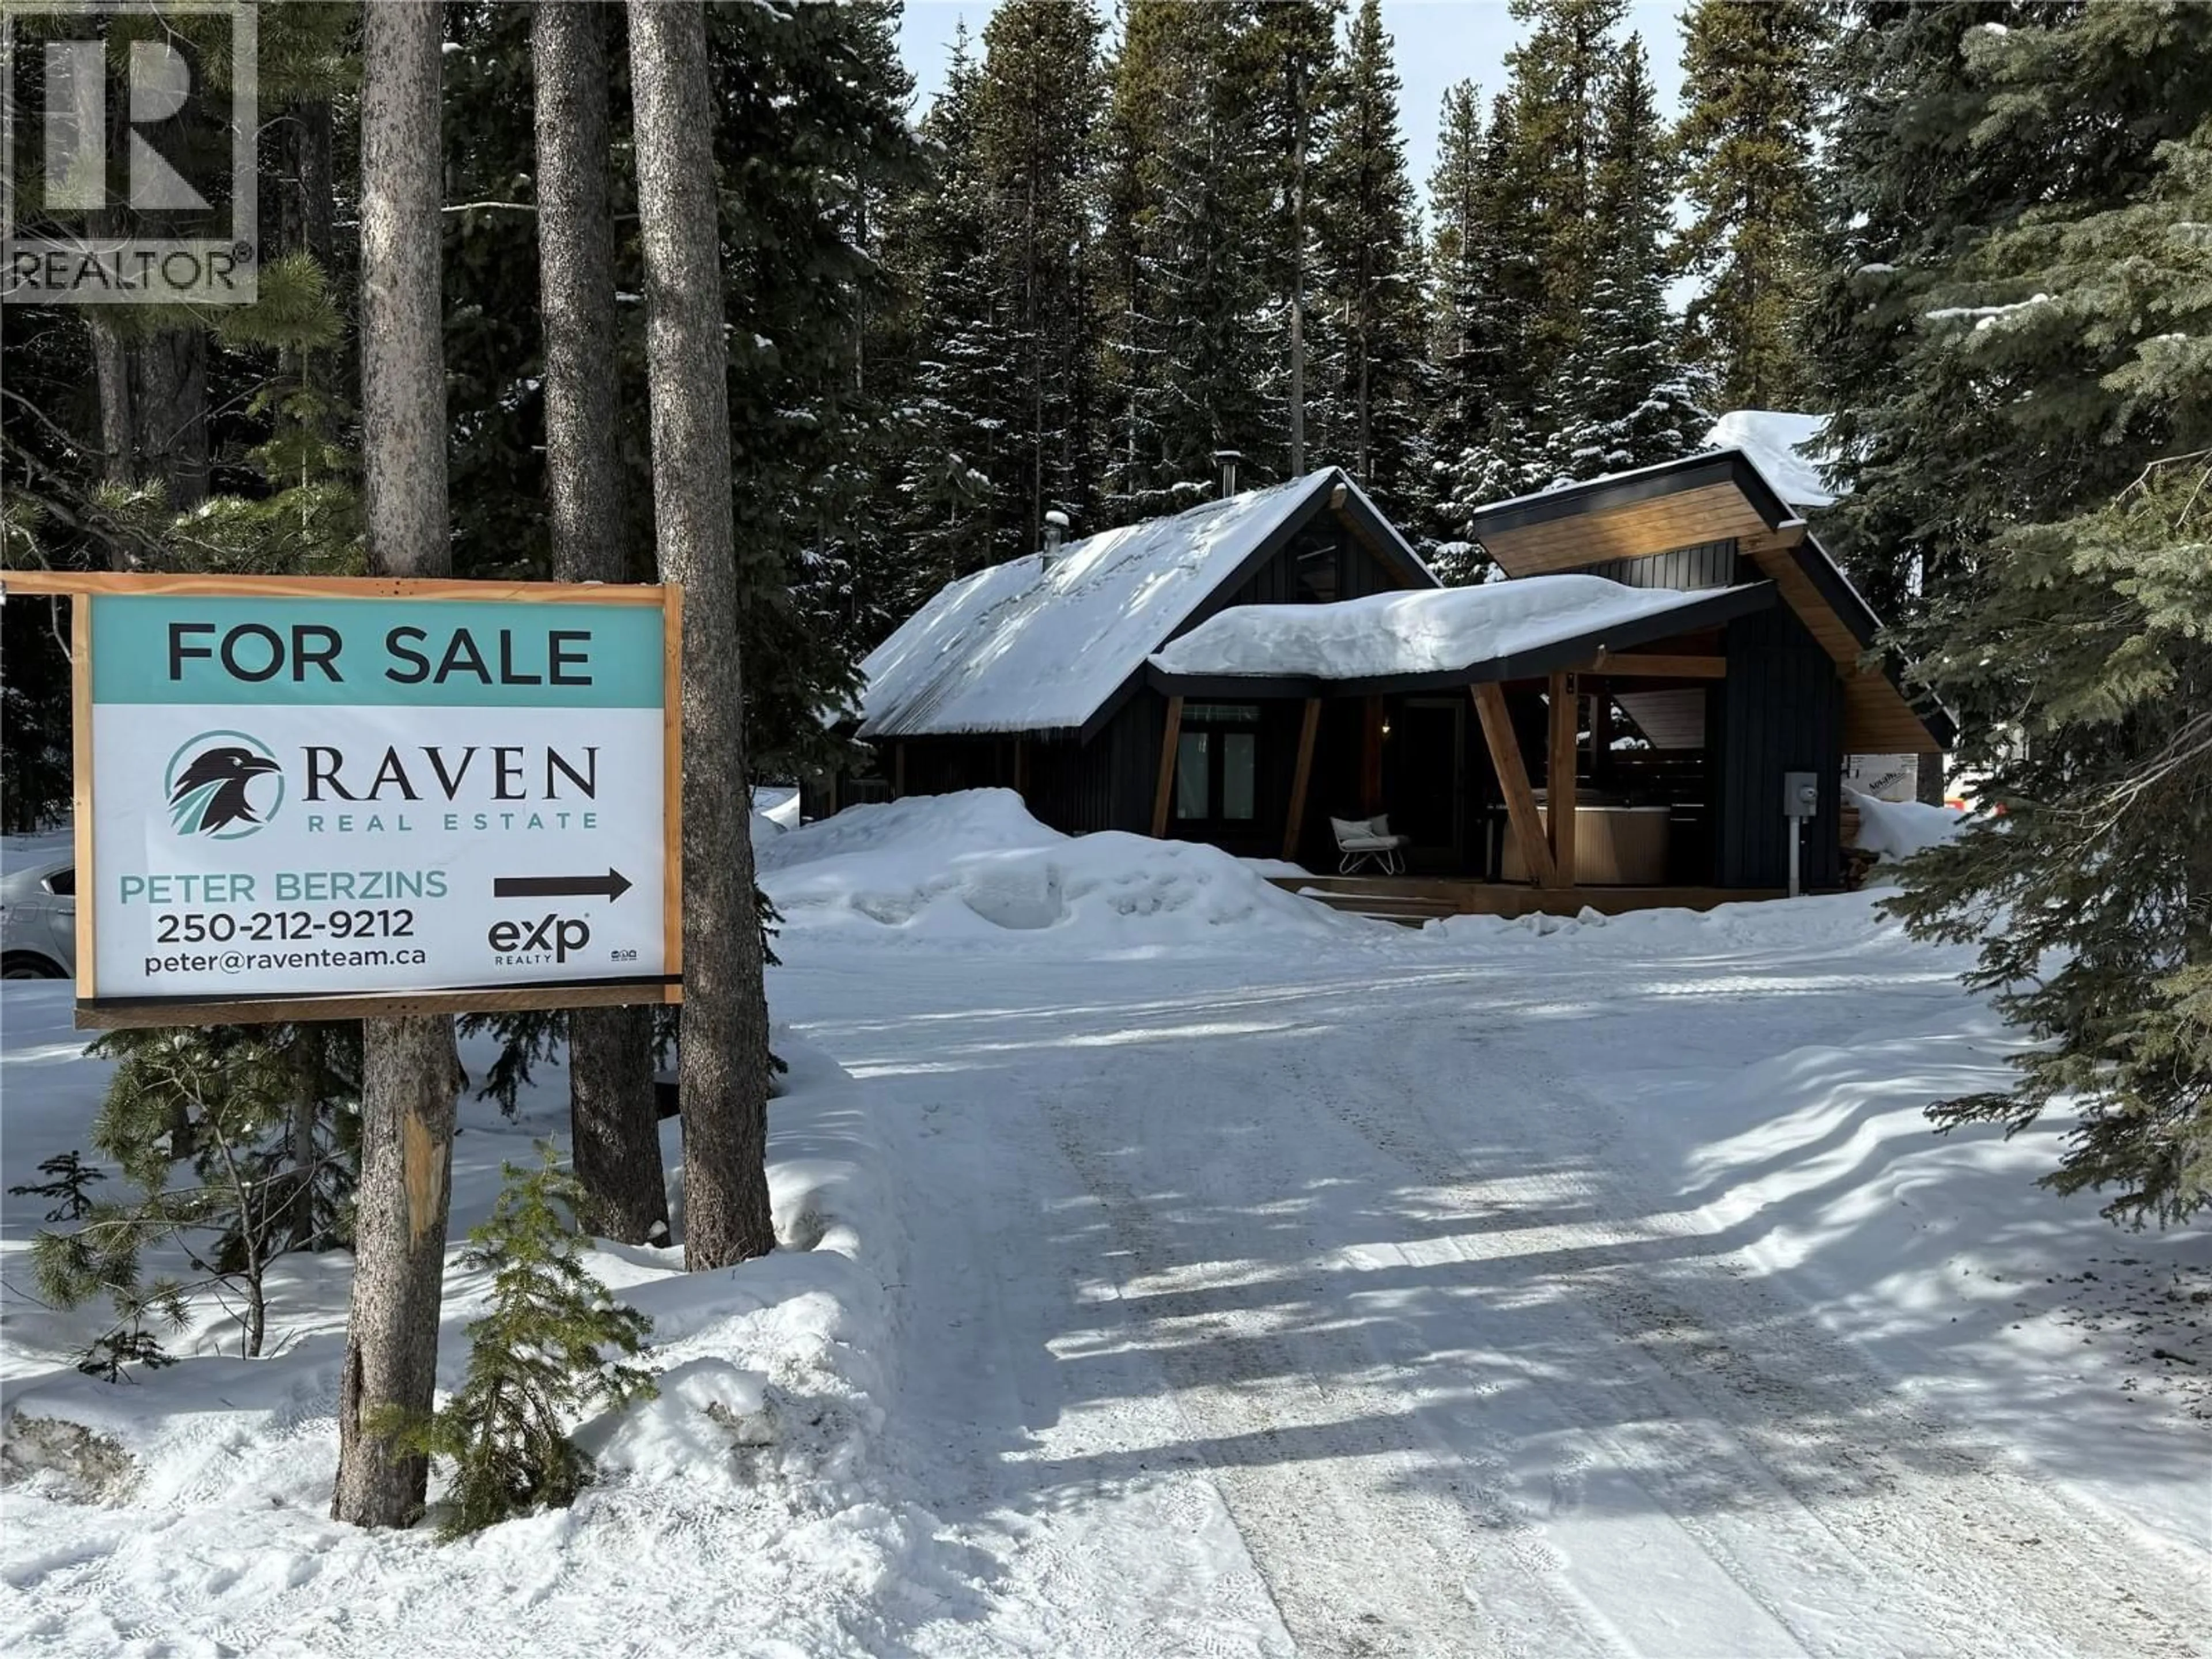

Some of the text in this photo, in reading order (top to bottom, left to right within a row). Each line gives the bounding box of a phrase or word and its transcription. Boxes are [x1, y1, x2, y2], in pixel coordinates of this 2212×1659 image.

[169, 623, 592, 685] FOR SALE
[300, 745, 600, 801] RAVEN
[308, 812, 597, 832] REAL ESTATE
[120, 870, 448, 904] PETER BERZINS
[157, 908, 414, 943] 250-212-9212
[145, 946, 426, 976] peter@raventeam.ca
[495, 955, 551, 965] REALTY
